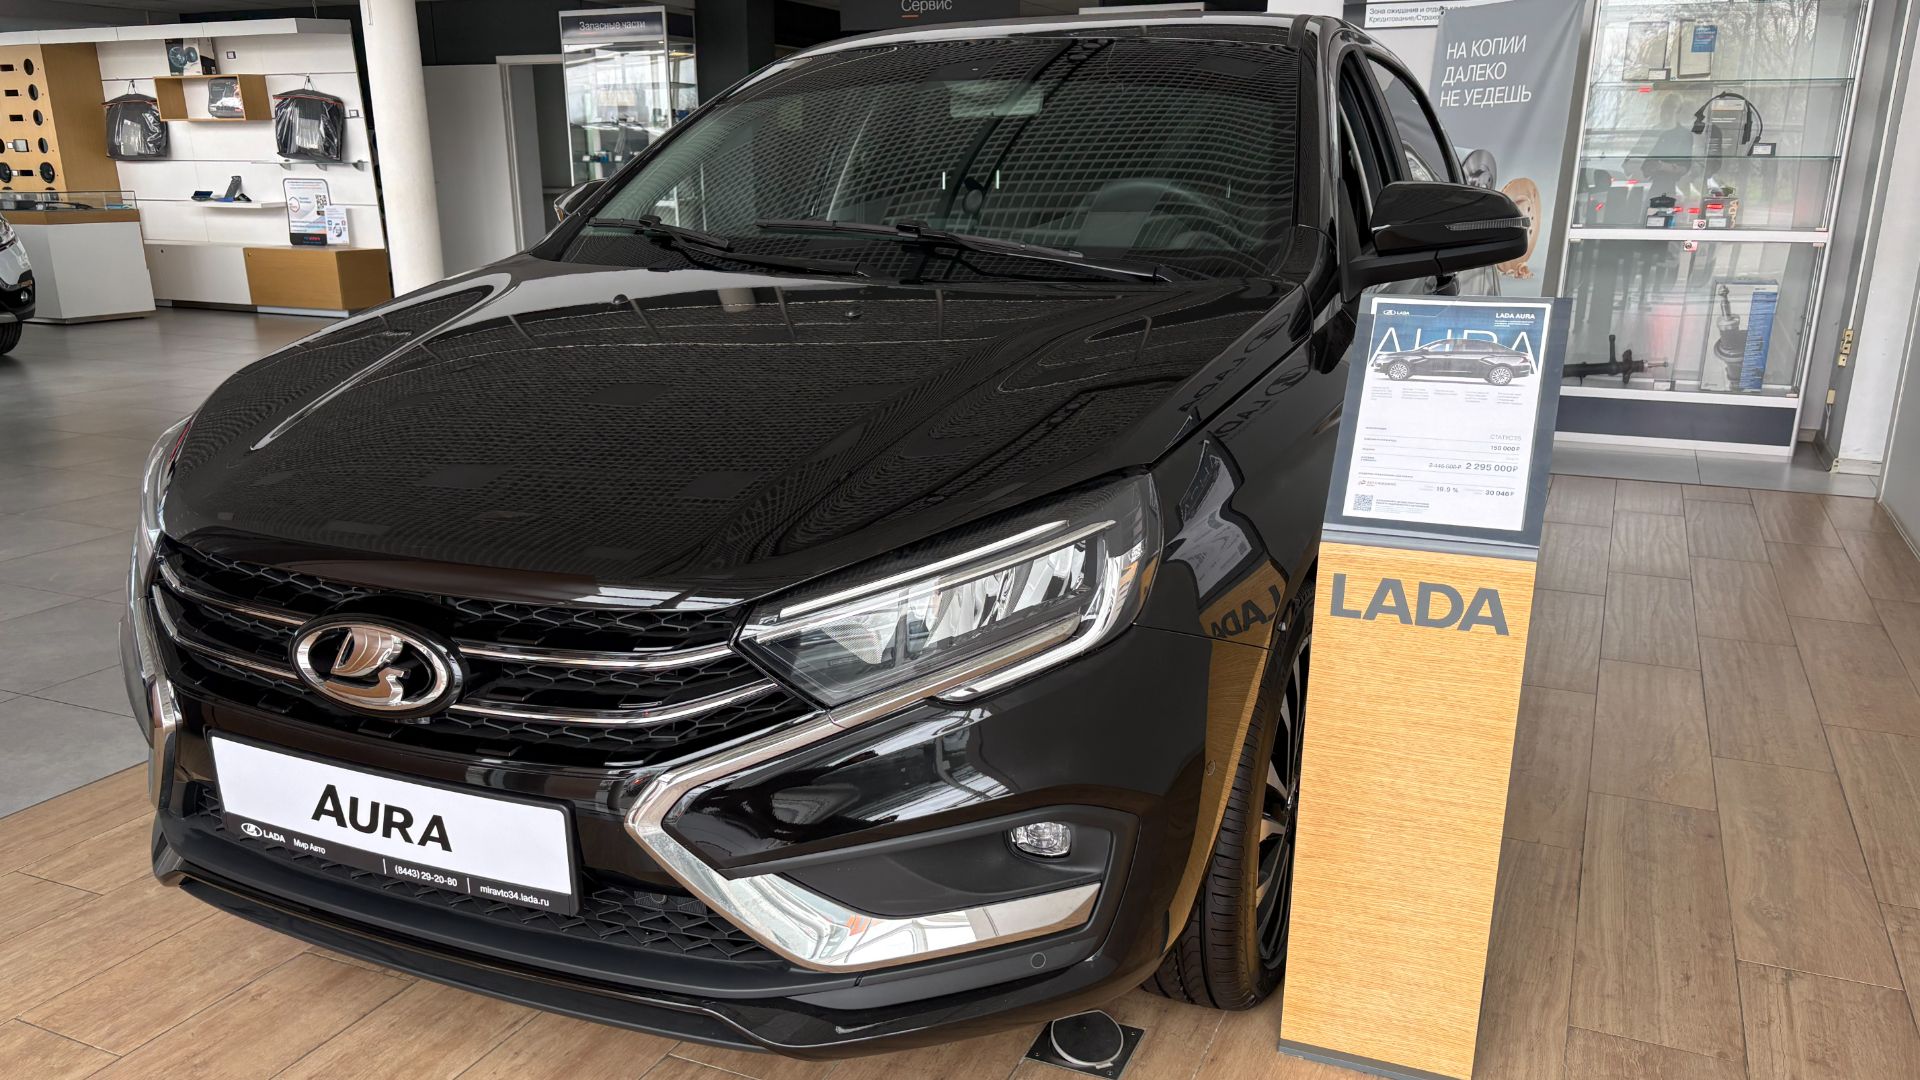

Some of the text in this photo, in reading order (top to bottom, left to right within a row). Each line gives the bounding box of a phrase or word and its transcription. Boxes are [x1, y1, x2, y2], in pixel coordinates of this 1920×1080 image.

[579, 20, 646, 31] Запасные части
[1446, 34, 1527, 60] НА КОПИИ
[1441, 61, 1507, 87] ДАЛЕКО
[1440, 84, 1532, 109] НЕ УЕДЕШЬ
[1465, 462, 1472, 470] 2
[1473, 463, 1492, 472] 295
[1330, 573, 1510, 636] LADA
[311, 783, 453, 853] AURA
[263, 829, 286, 843] LADA
[293, 837, 326, 855] Мир Авто
[394, 864, 458, 887] (8443) 29-20-80
[479, 885, 550, 907] miravto34.lada.ru
